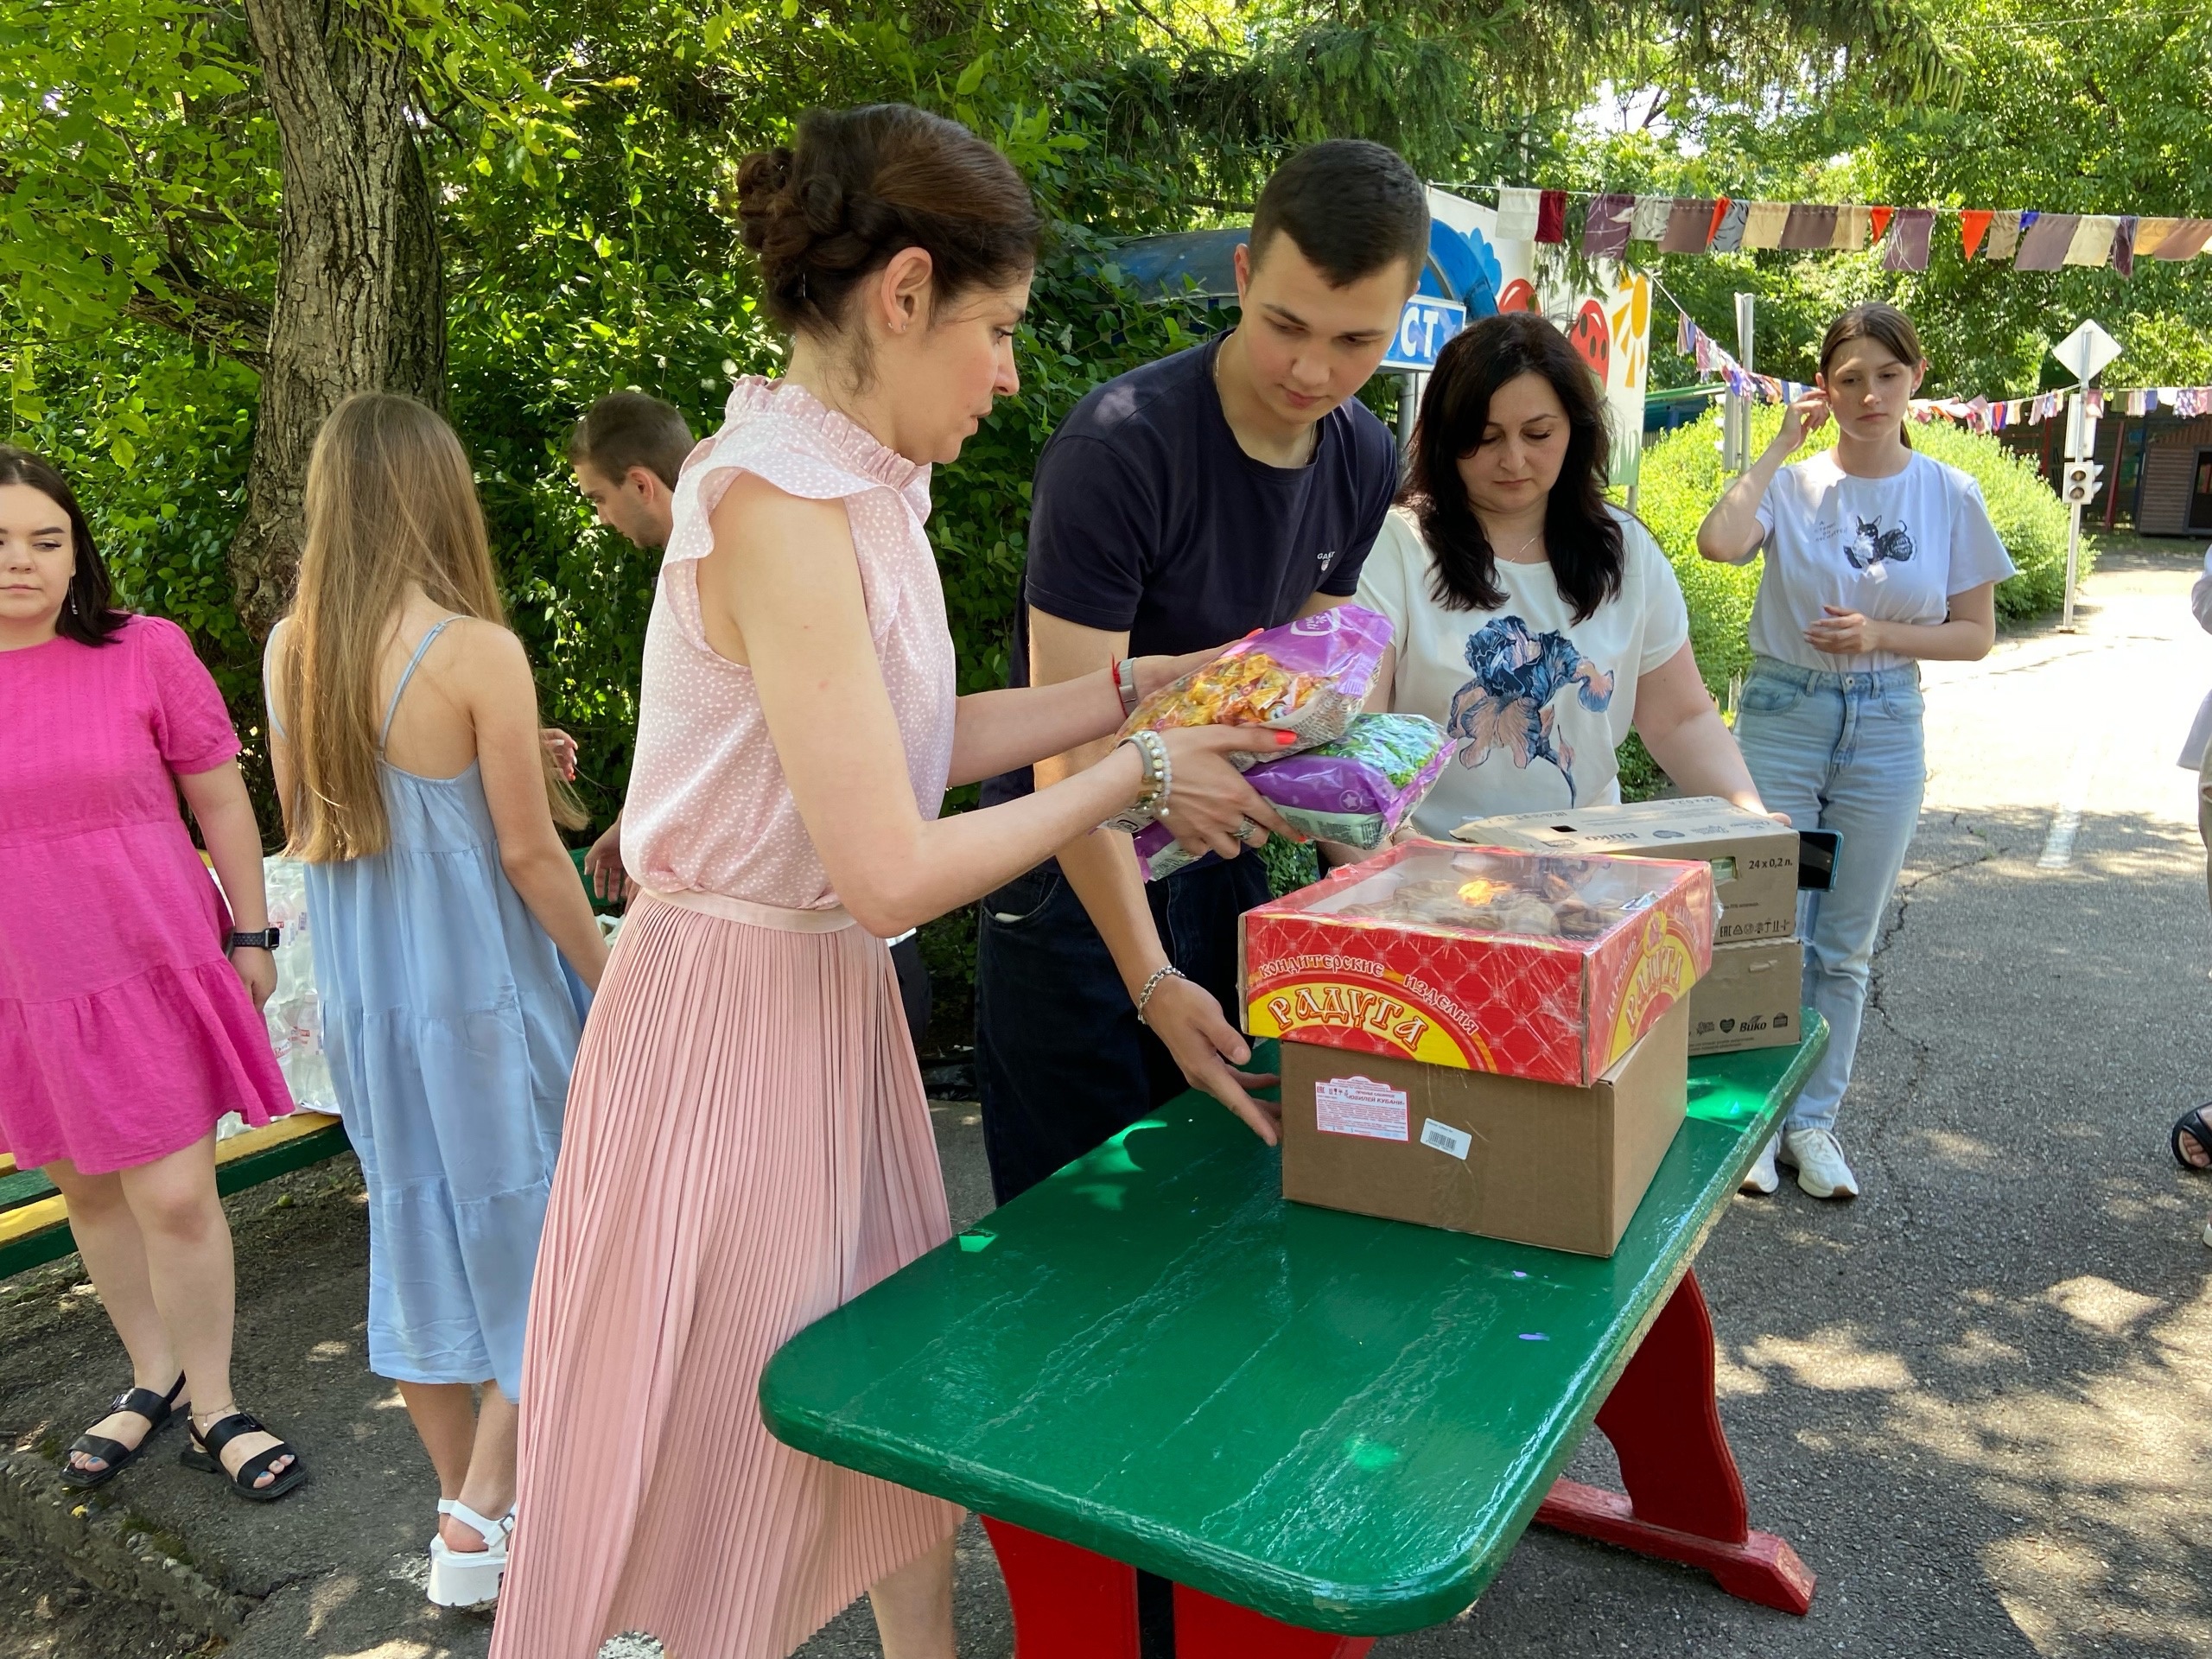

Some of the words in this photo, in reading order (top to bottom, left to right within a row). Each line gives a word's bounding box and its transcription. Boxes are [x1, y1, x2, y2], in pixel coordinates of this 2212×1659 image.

[1386, 306, 1439, 358] СТ
[1748, 860, 1760, 869] 24
[1770, 858, 1783, 868] 0,2
[1268, 987, 1429, 1052] РАДУГА
[1739, 1021, 1767, 1033] Вико
